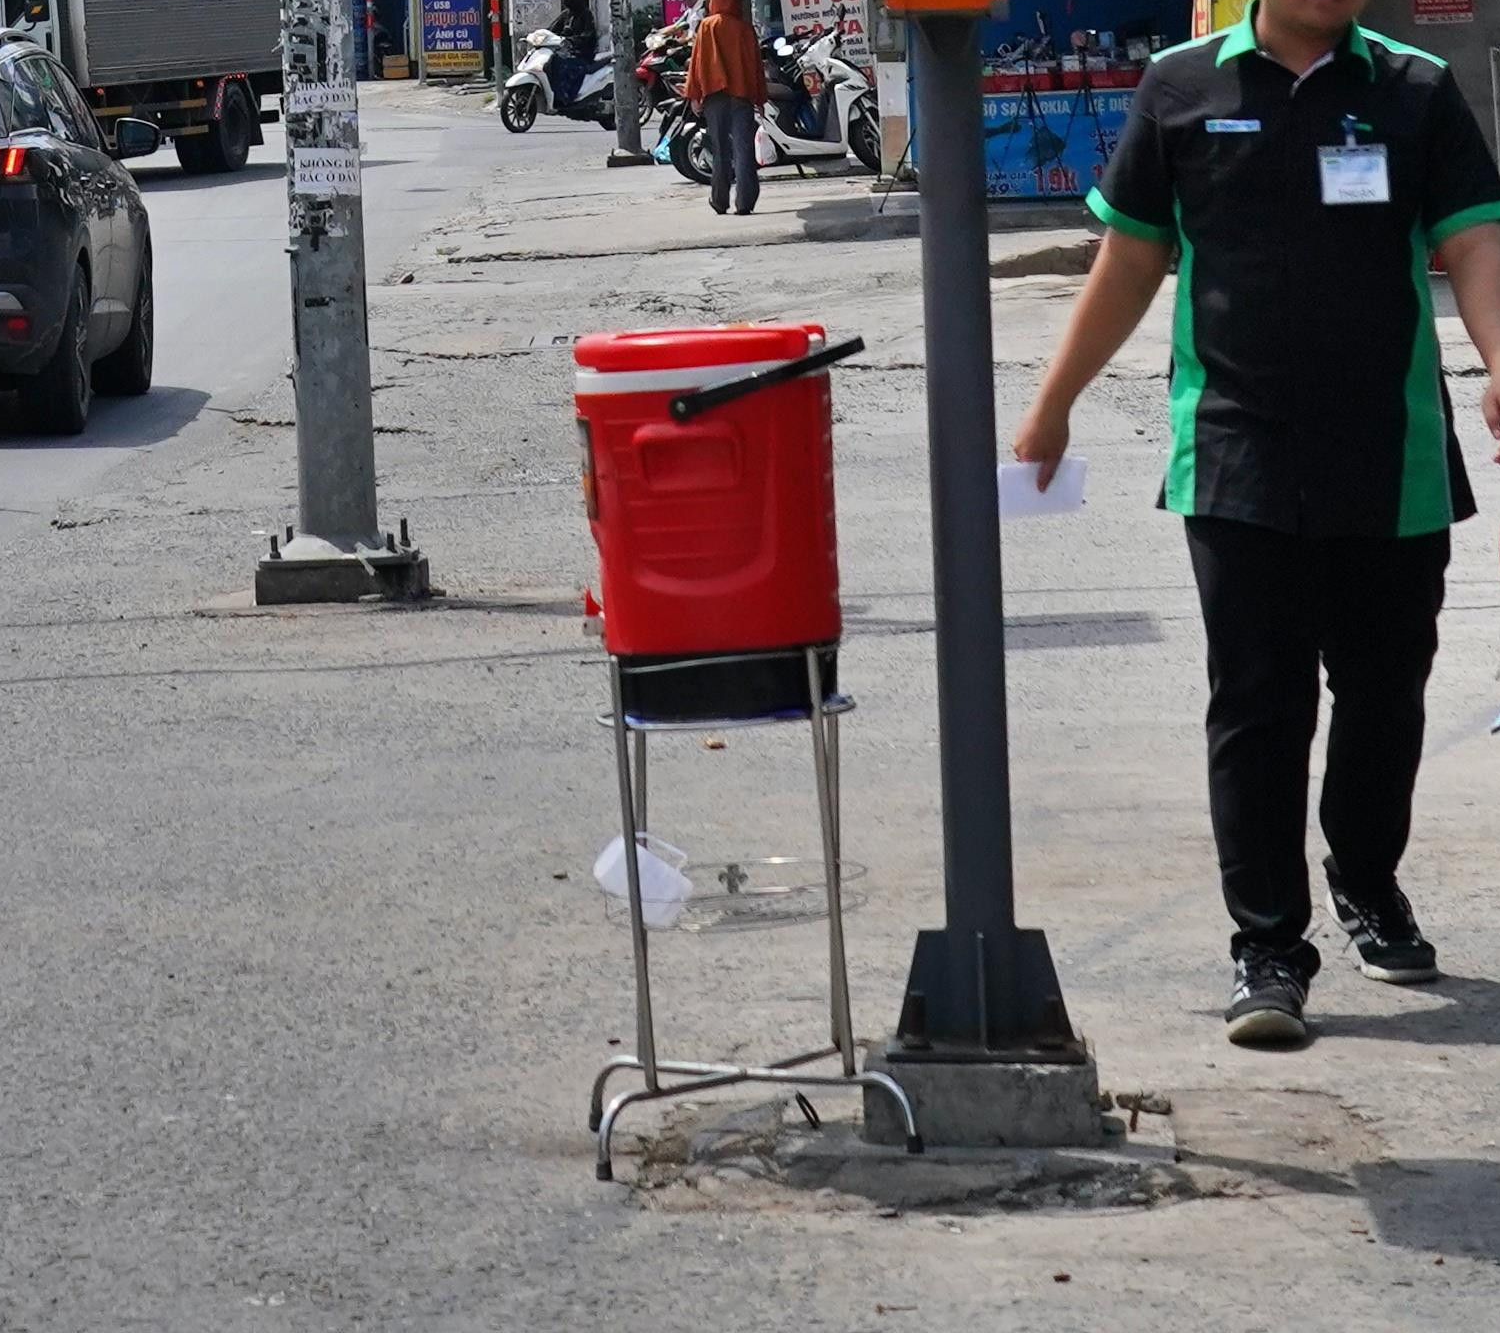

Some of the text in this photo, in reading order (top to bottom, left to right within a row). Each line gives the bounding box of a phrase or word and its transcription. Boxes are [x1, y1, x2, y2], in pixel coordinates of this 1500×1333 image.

[299, 155, 341, 171] KHÔNG
[298, 170, 323, 183] RÁC
[1033, 167, 1079, 195] 19k
